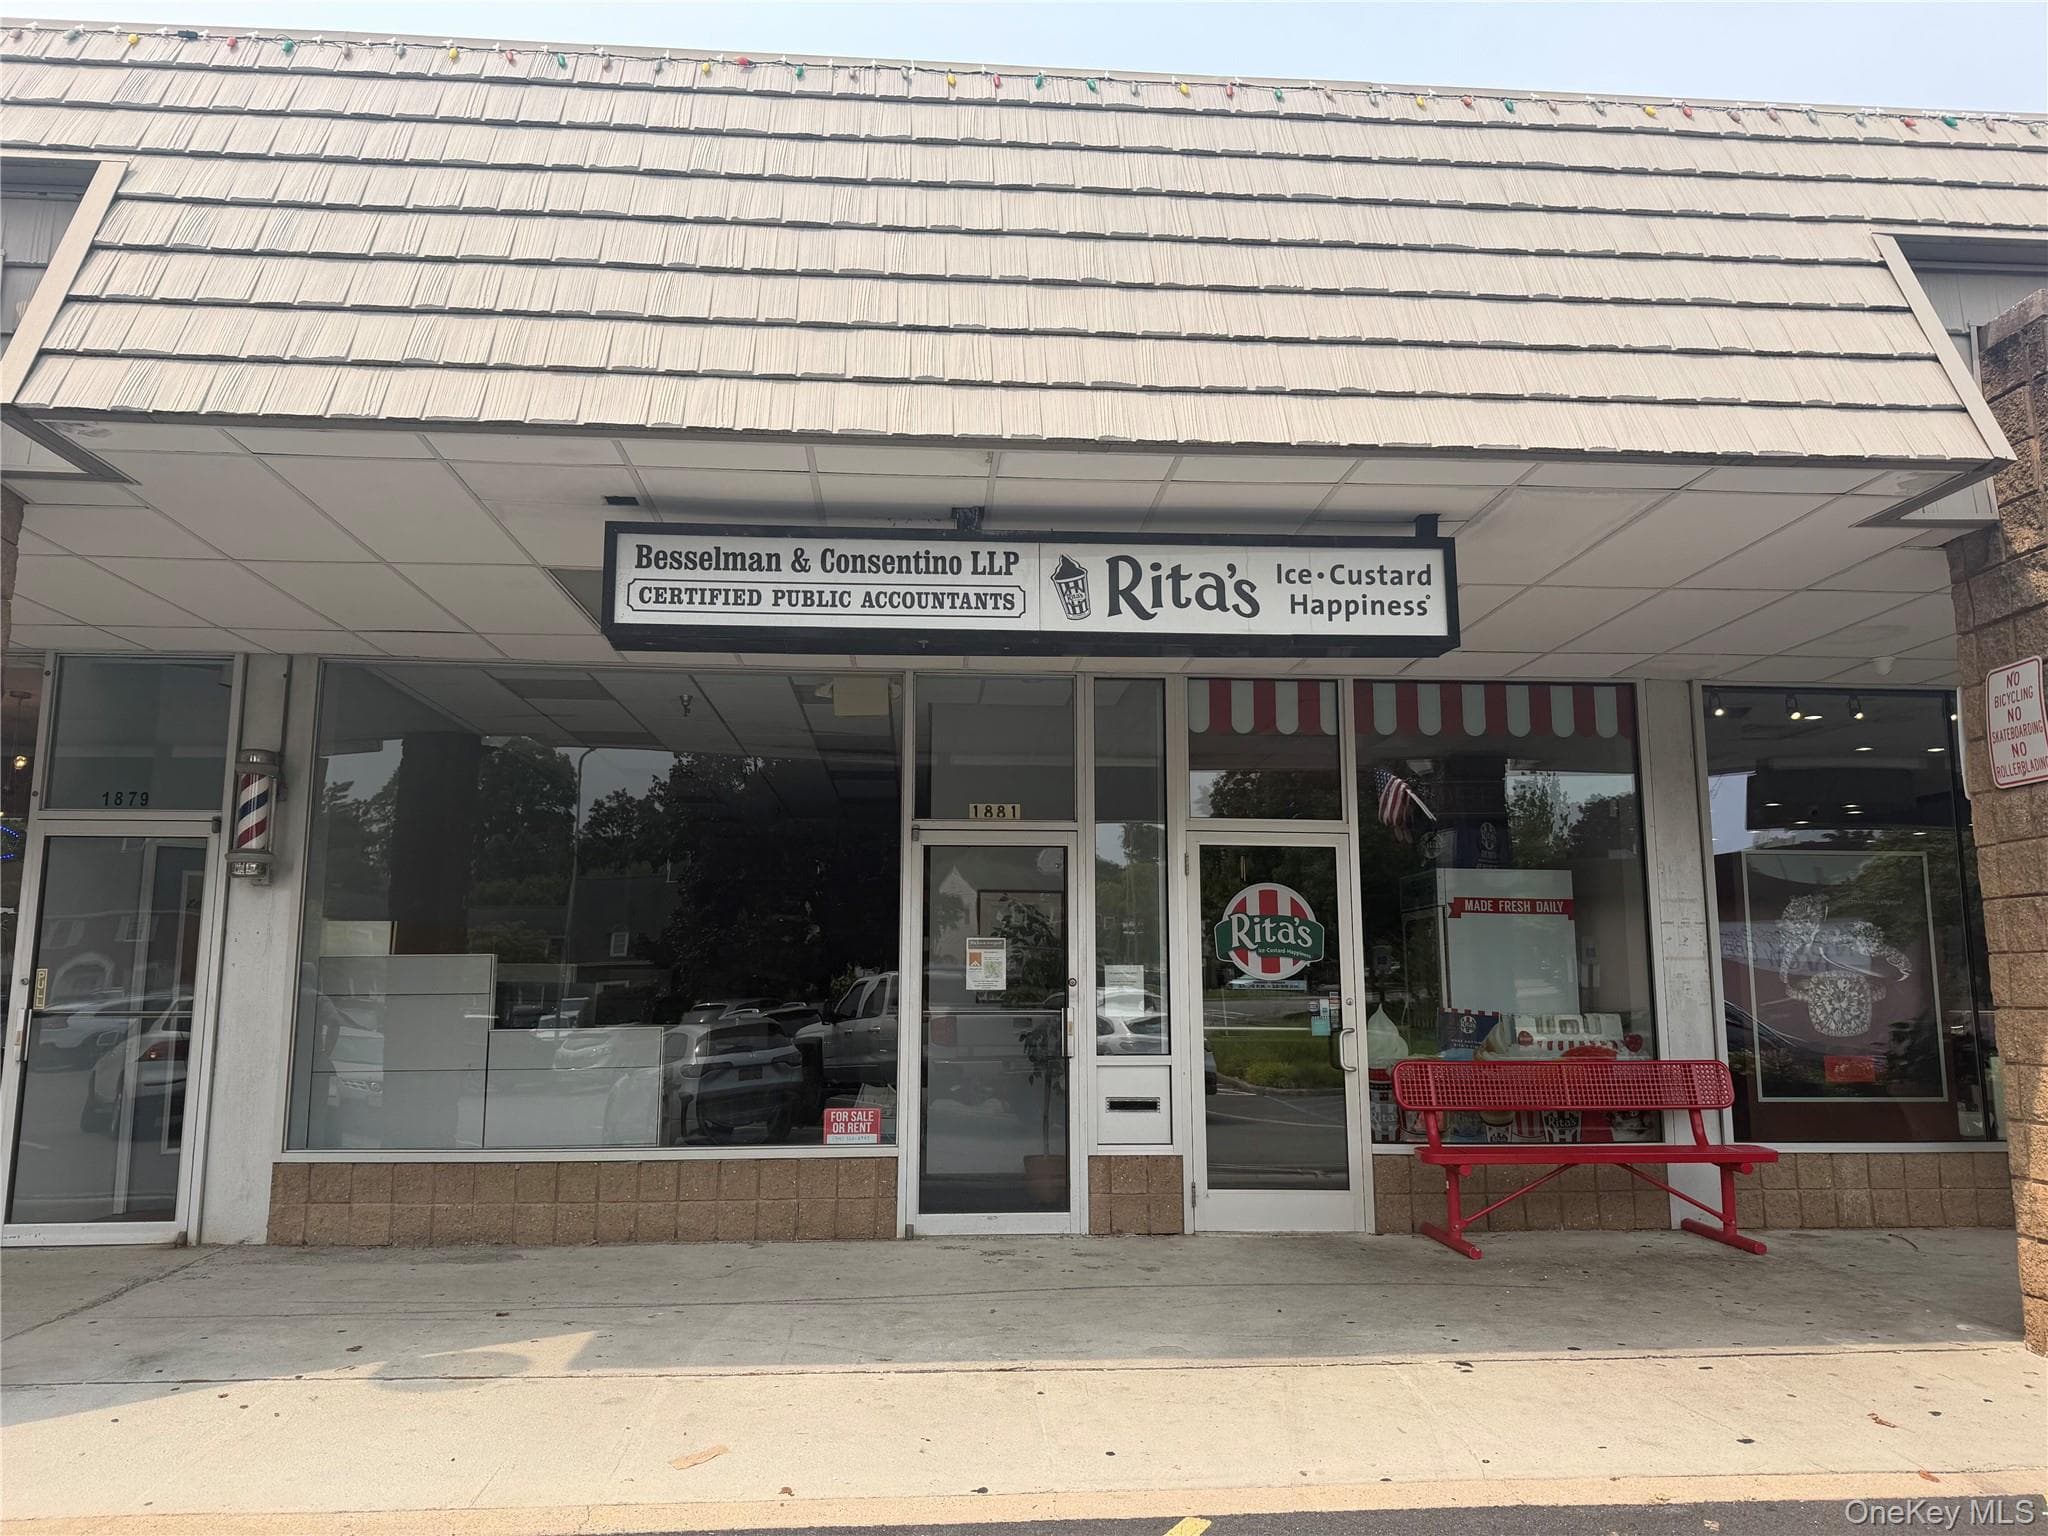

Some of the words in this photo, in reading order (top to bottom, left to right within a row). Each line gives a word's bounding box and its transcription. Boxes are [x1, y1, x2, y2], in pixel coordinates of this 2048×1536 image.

[635, 544, 782, 573] Besselman
[791, 548, 812, 573] &
[820, 548, 962, 576] Consentino
[971, 550, 1020, 577] LLP
[1276, 563, 1312, 585] Ice
[1330, 563, 1432, 586] Custard
[1106, 554, 1261, 621] Rita's
[638, 586, 763, 607] CERTIFIED
[772, 588, 852, 609] PUBLIC
[860, 590, 1016, 611] ACCOUNTANTS
[2006, 671, 2020, 689] NO
[1994, 685, 2033, 709] BICYCLING
[2007, 706, 2022, 723] NO
[1991, 720, 2043, 744] SKATEBOARDING
[2011, 741, 2027, 759] NO
[102, 791, 149, 806] 1879
[973, 804, 1016, 819] 1881
[1464, 899, 1494, 912] MADE
[1498, 900, 1531, 913] FRESH
[1536, 900, 1564, 913] DAILY
[1230, 913, 1313, 949] Rita's
[35, 971, 45, 1007] PULL
[830, 1111, 848, 1122] FOR
[851, 1110, 874, 1122] SALE
[832, 1122, 845, 1133] OR
[847, 1122, 872, 1133] RENT
